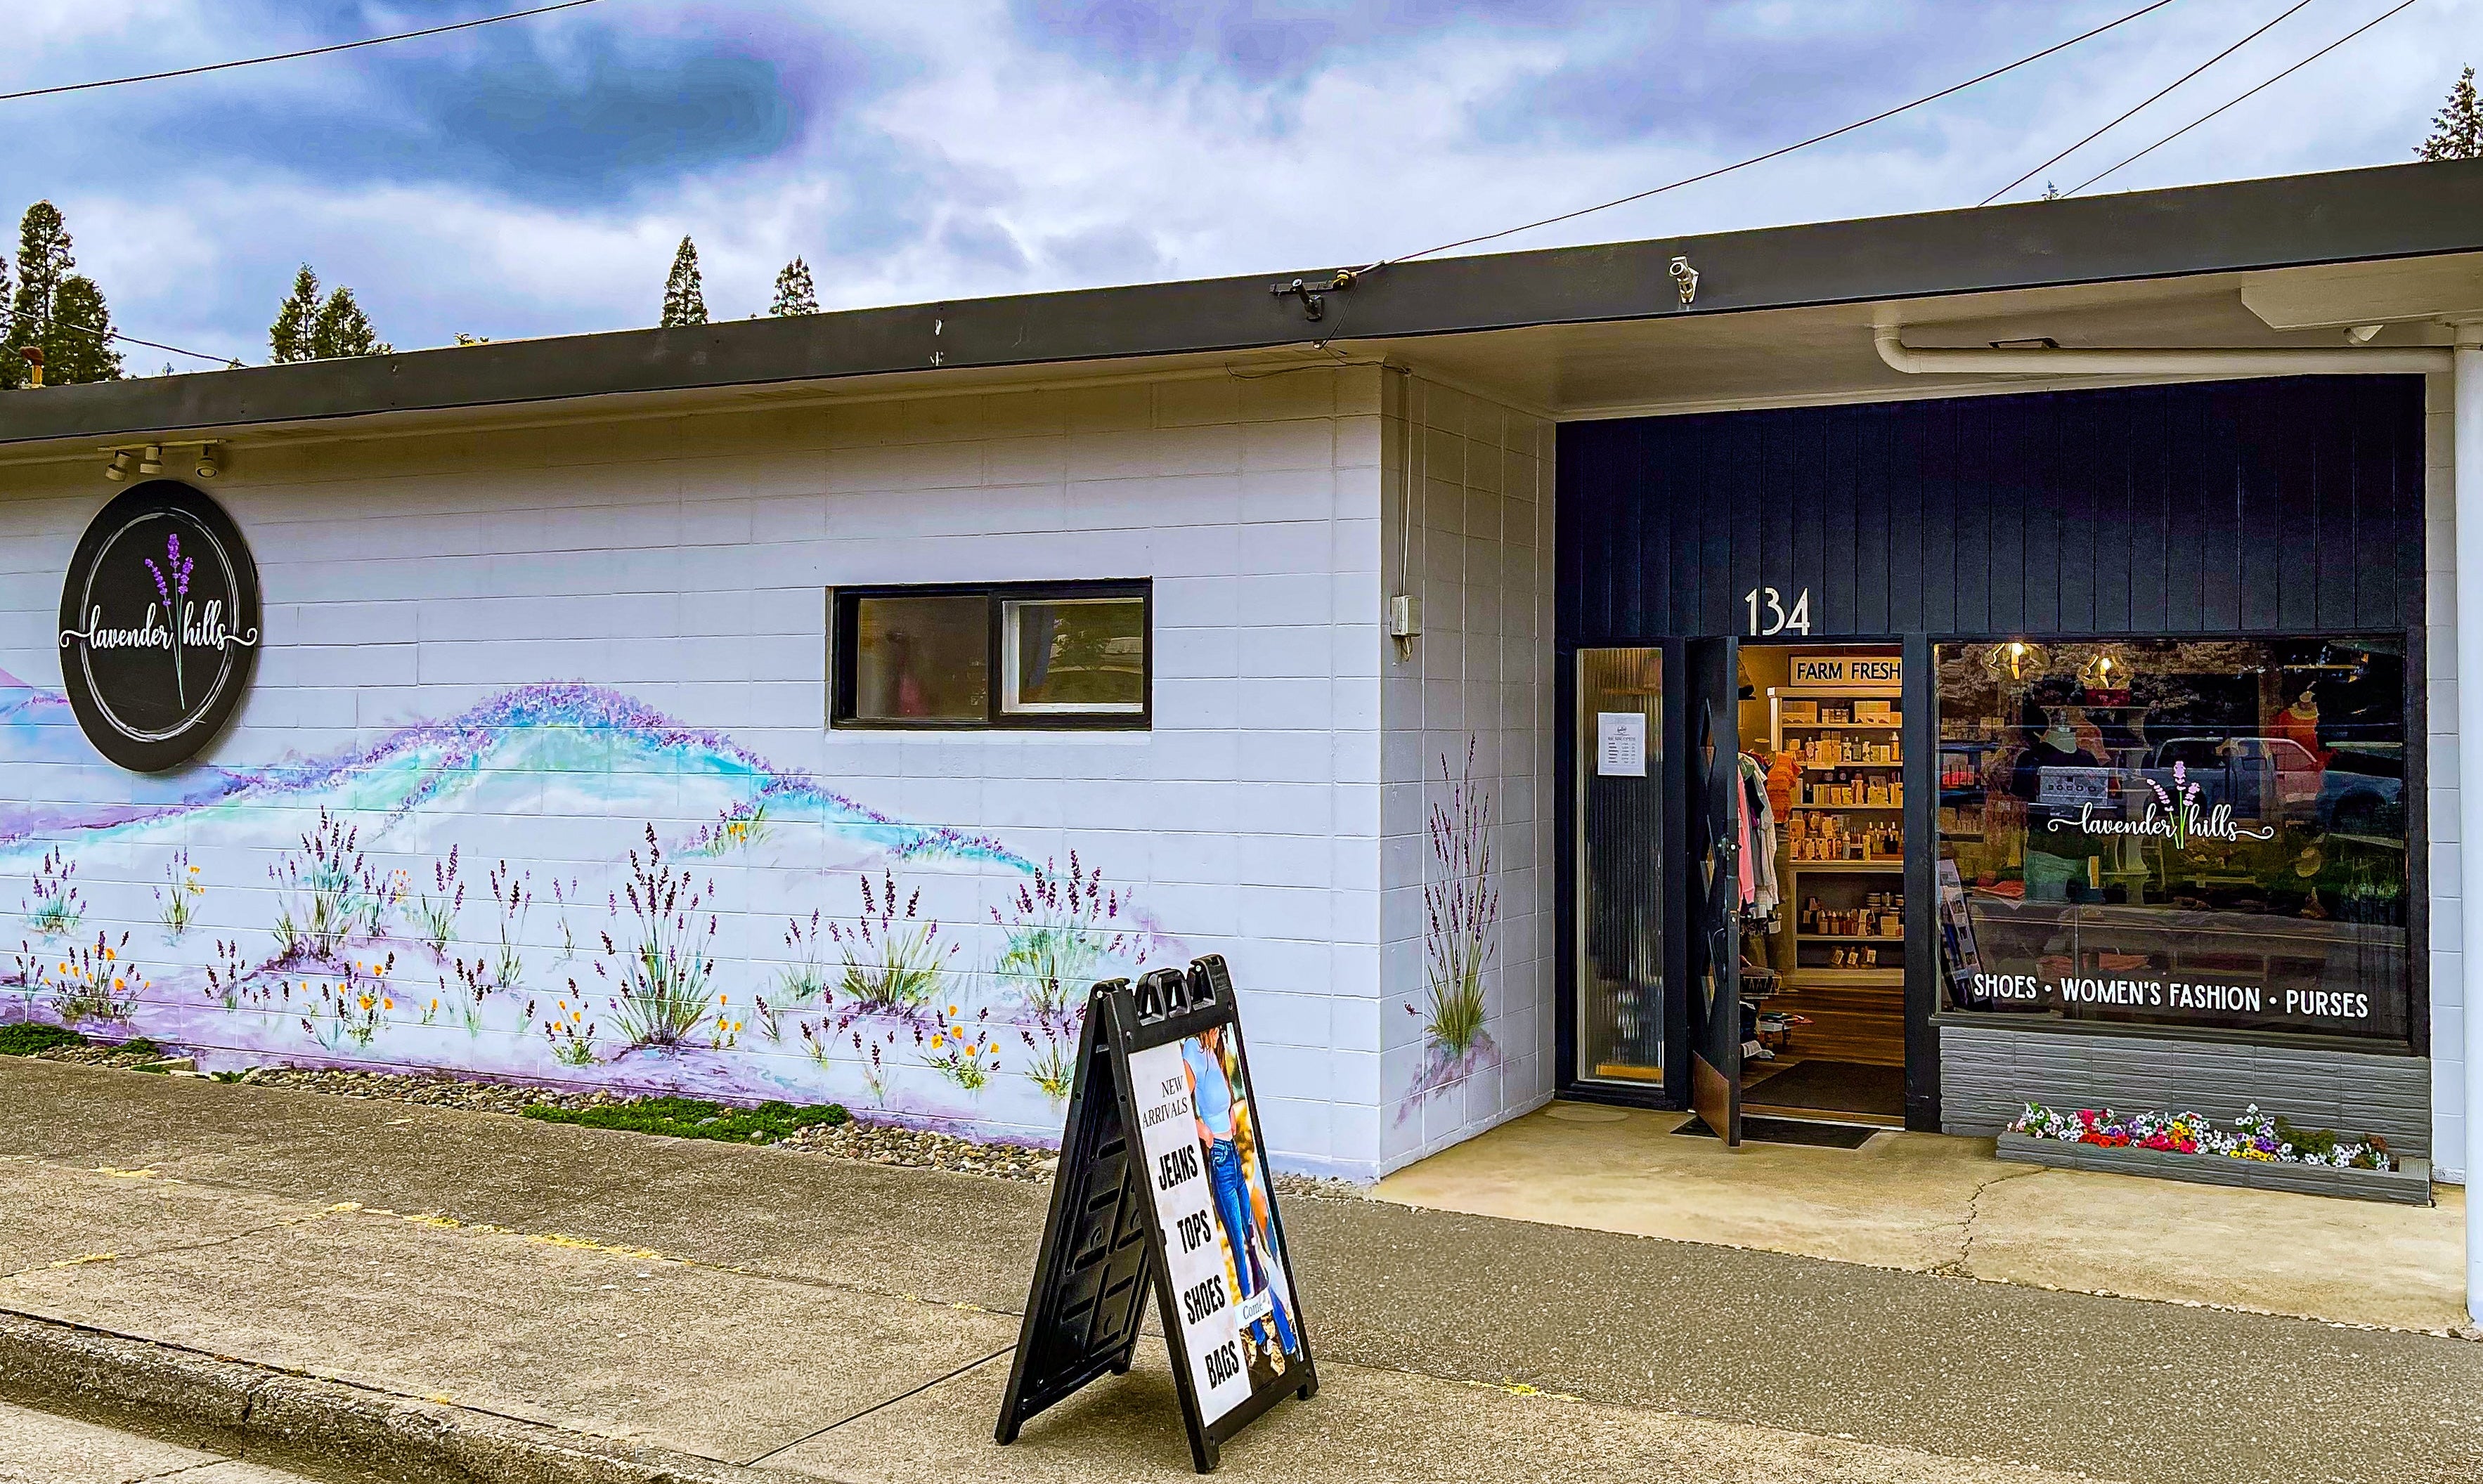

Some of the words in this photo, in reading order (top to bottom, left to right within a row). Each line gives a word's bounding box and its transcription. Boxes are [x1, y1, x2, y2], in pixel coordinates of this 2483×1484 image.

[60, 602, 173, 650] lavender
[183, 599, 257, 651] hills
[1744, 587, 1810, 636] 134
[1797, 663, 1843, 679] FARM
[1851, 663, 1900, 679] FRESH
[2047, 802, 2177, 840] lavender
[2189, 802, 2274, 841] hills
[1973, 973, 2037, 999] SHOES
[2061, 977, 2161, 1005] WOMEN'S
[2169, 982, 2260, 1012] FASHION
[2286, 989, 2368, 1018] PURSES
[1162, 1076, 1183, 1098] NEW
[1143, 1099, 1188, 1128] ARRIVALS
[1158, 1144, 1198, 1190] JEANS
[1177, 1210, 1212, 1254] TOPS
[1184, 1274, 1226, 1324] SHOES
[1205, 1340, 1240, 1390] BAGS
